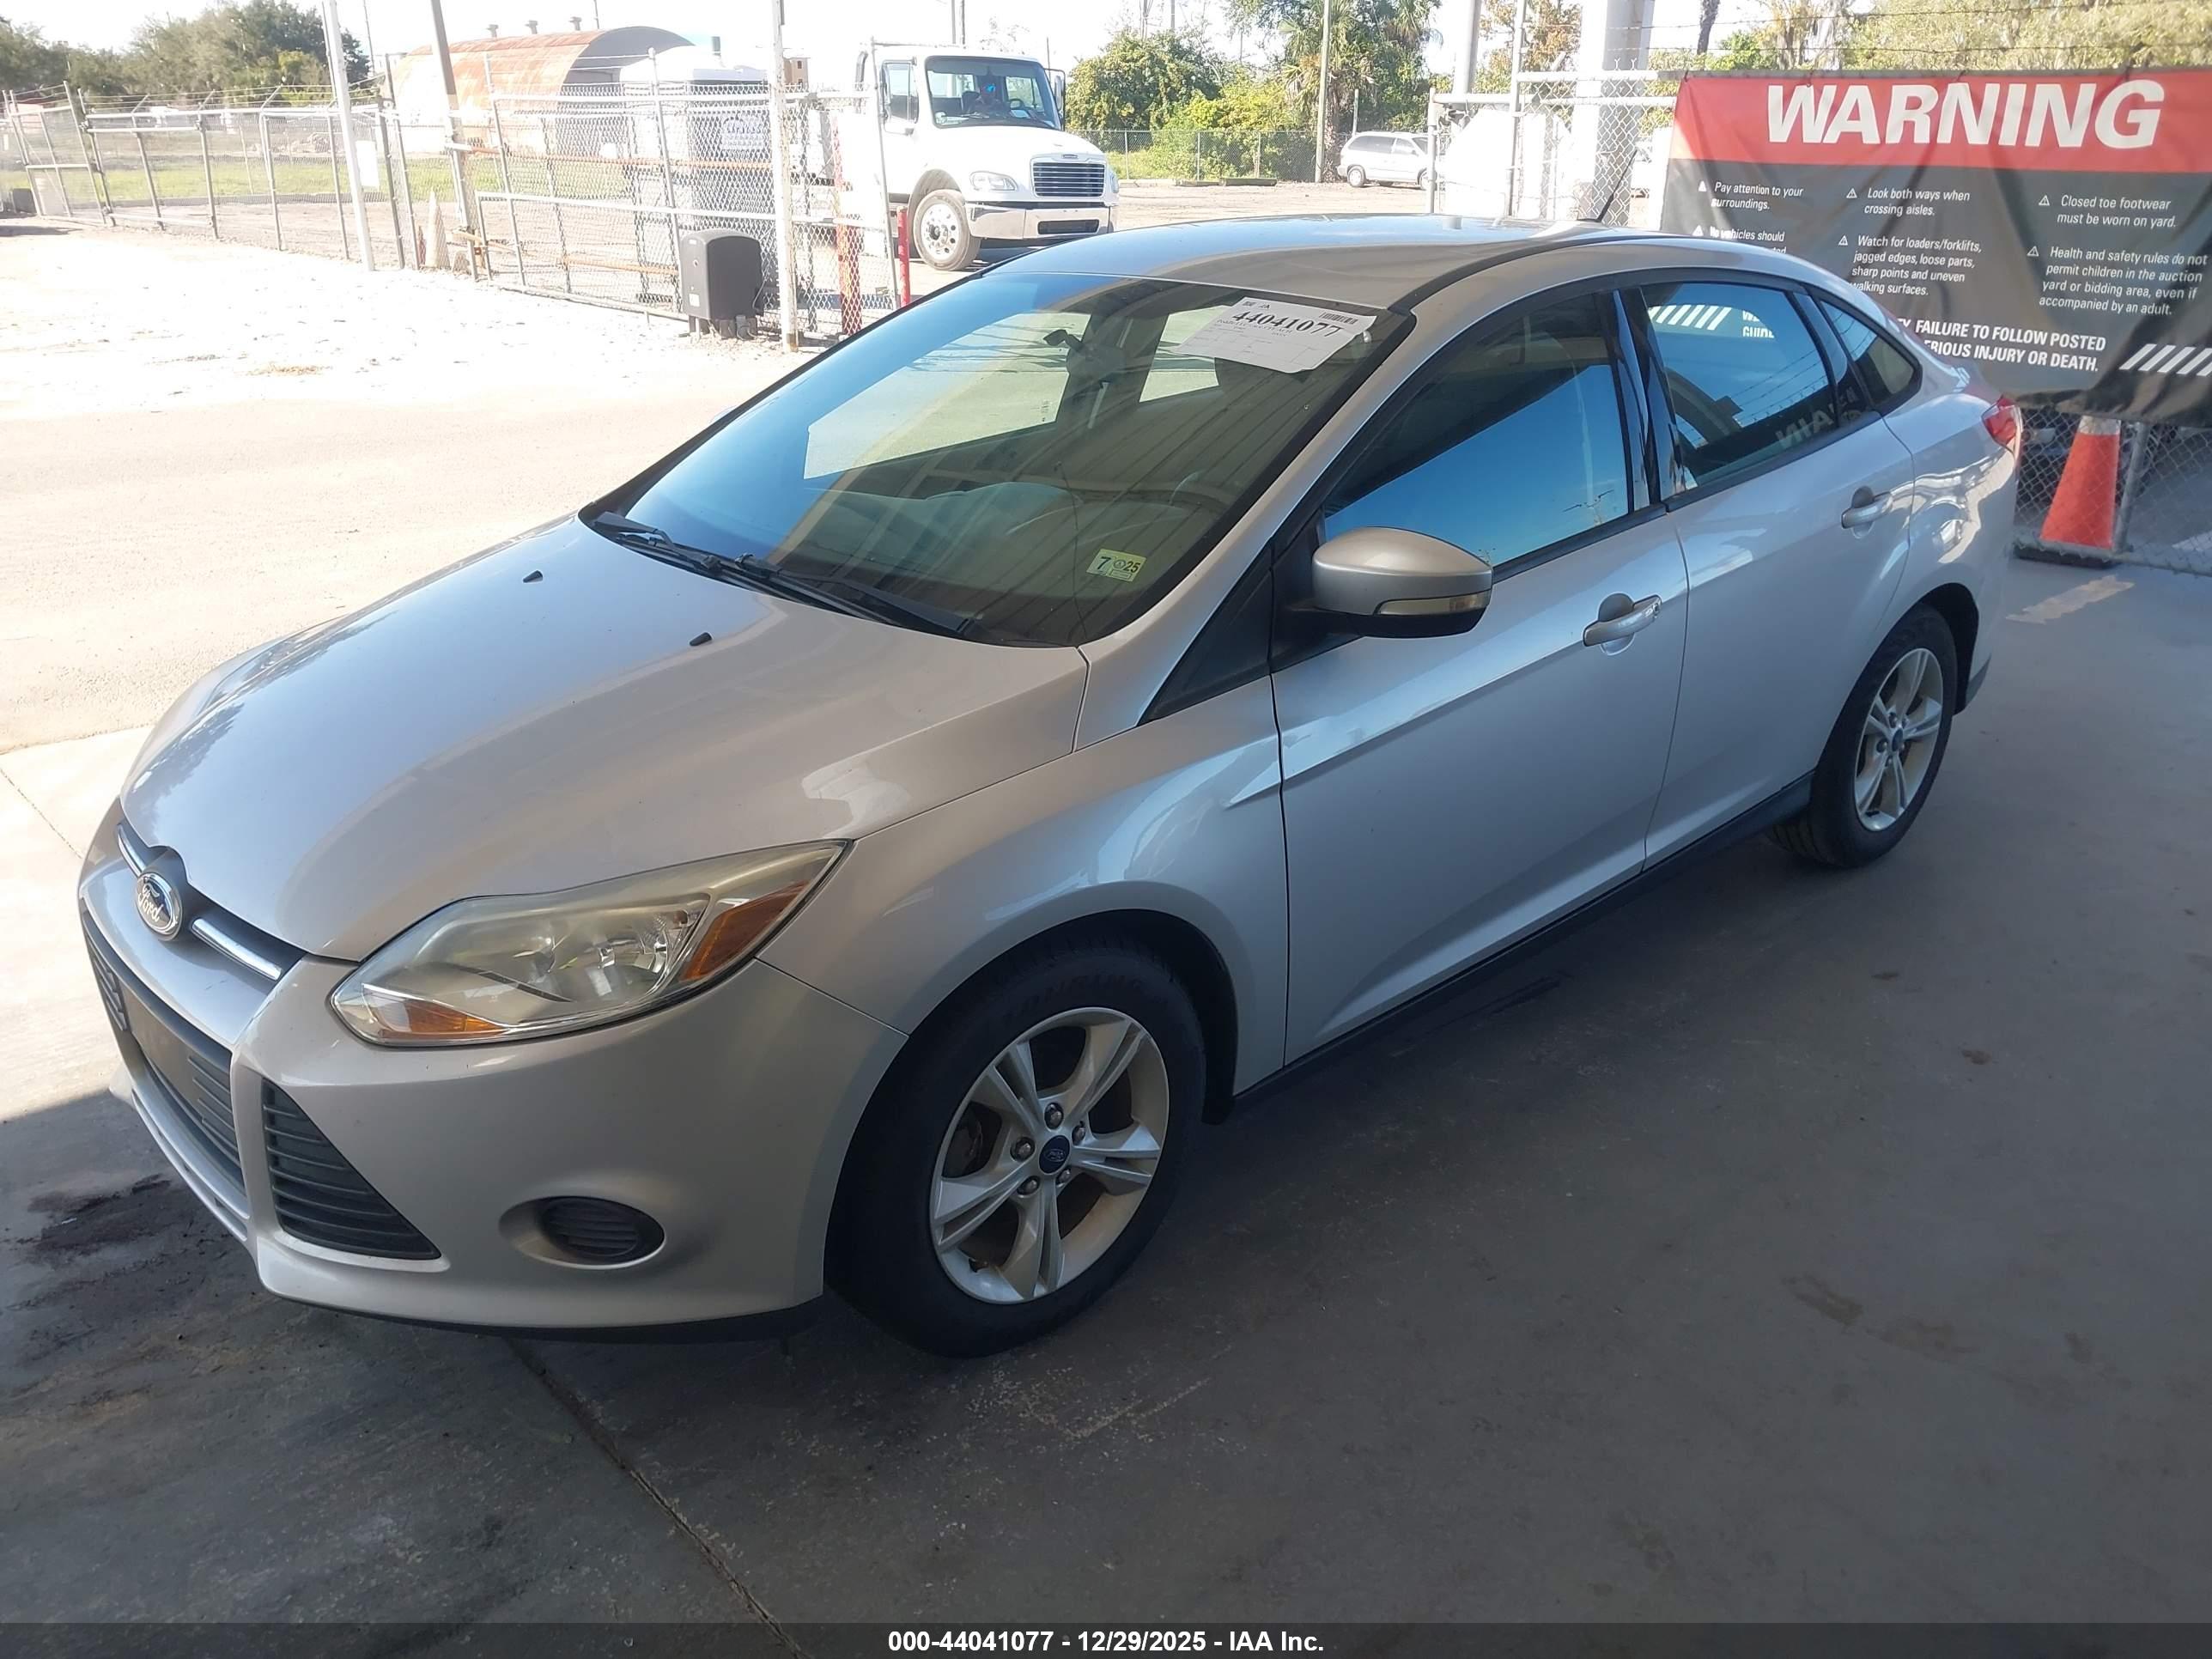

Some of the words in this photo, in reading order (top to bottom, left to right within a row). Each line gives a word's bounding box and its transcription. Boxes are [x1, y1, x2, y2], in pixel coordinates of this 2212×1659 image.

[1768, 79, 2164, 149] WARNING
[1715, 182, 1731, 194] Pay
[1734, 185, 1769, 195] attention
[1771, 186, 1781, 196] to
[1784, 187, 1803, 198] your
[1868, 188, 1888, 198] Look
[1891, 188, 1912, 199] both
[1915, 191, 1940, 201] ways
[1943, 190, 1970, 201] when
[1711, 198, 1770, 211] surroundings.
[1864, 204, 1903, 216] crossing
[1906, 204, 1935, 216] aisles.
[2061, 195, 2096, 207] Closed
[2099, 198, 2116, 209] toe
[2119, 198, 2171, 210] footwear
[2057, 213, 2083, 224] must
[2086, 213, 2099, 225] be
[2103, 216, 2130, 227] worn
[2134, 217, 2147, 227] on
[2150, 216, 2176, 229] yard.
[1721, 229, 1755, 240] vehicles
[1758, 229, 1784, 241] should
[1857, 235, 1888, 247] Watch
[1891, 236, 1906, 247] for
[1906, 237, 1982, 253] loaders/forklifts,
[1853, 251, 1885, 264] jagged
[1888, 252, 1917, 265] edges,
[1920, 253, 1945, 265] loose
[1948, 257, 1976, 268] parts,
[2050, 246, 2083, 259] Health
[2086, 249, 2105, 261] and
[2107, 251, 2141, 264] safety
[2142, 252, 2169, 264] rules
[2172, 253, 2185, 265] do
[2187, 254, 2208, 265] not
[1852, 266, 1878, 277] sharp
[1881, 268, 1909, 279] points
[1911, 270, 1928, 281] and
[1930, 271, 1965, 283] uneven
[2046, 264, 2080, 276] permit
[2082, 265, 2123, 278] children
[2125, 267, 2136, 278] in
[2138, 268, 2155, 281] the
[2158, 270, 2203, 283] auction
[1887, 283, 1929, 296] surfaces.
[2043, 280, 2067, 292] yard
[2069, 282, 2081, 292] or
[2085, 281, 2123, 297] bidding
[2126, 286, 2151, 298] area,
[2155, 289, 2185, 299] even
[2188, 287, 2198, 300] if
[2039, 297, 2109, 310] accompanied
[2111, 300, 2124, 313] by
[2125, 302, 2138, 313] an
[2141, 302, 2172, 315] adult.
[1232, 311, 1345, 337] 44041077
[1915, 320, 1969, 337] FAILURE
[1972, 324, 1990, 339] TO
[1992, 326, 2047, 345] FOLLOW
[2050, 332, 2106, 351] POSTED
[1974, 344, 2025, 363] INJURY
[2028, 350, 2047, 366] OR
[2051, 354, 2099, 372] DEATH.
[1097, 556, 1111, 569] 7
[1123, 561, 1140, 573] 25
[137, 883, 164, 922] Ford
